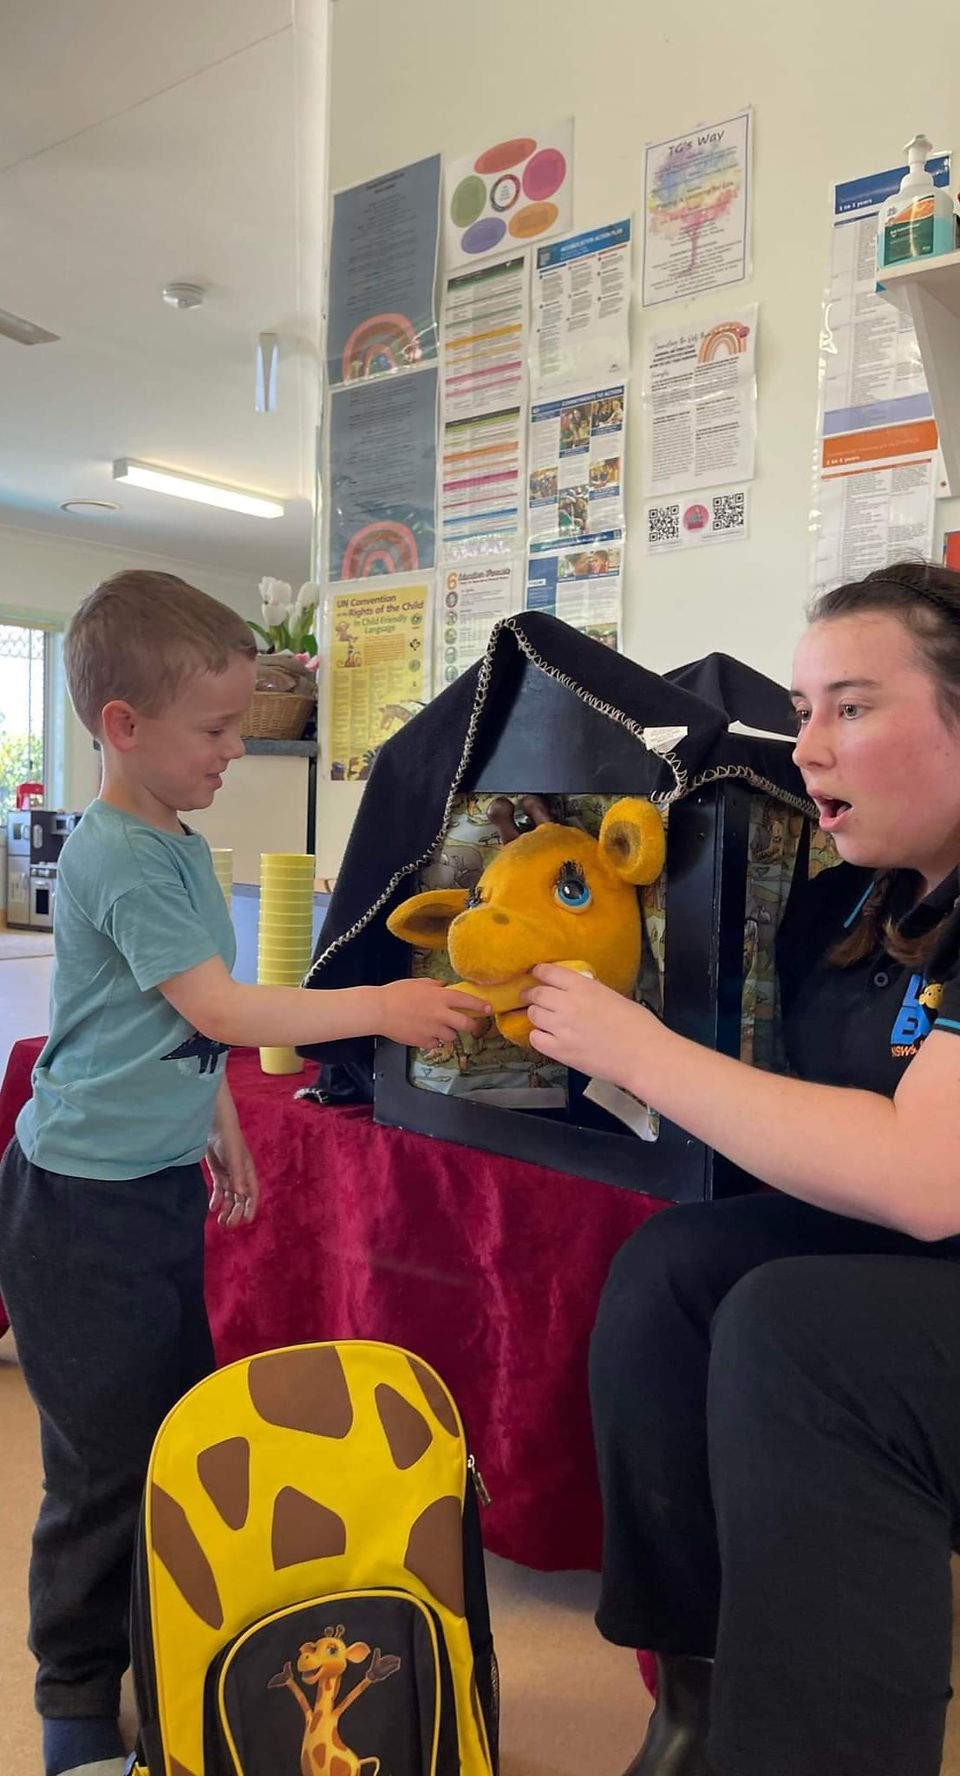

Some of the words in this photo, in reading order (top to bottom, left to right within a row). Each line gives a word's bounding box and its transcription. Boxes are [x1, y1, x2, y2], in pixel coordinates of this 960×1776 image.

[698, 130, 725, 146] Way
[857, 198, 873, 208] years
[447, 572, 457, 590] 6
[337, 599, 349, 608] UN
[350, 595, 397, 607] Convention
[348, 608, 373, 618] Rights
[375, 604, 384, 613] of
[386, 603, 400, 613] the
[402, 600, 424, 611] Child
[361, 616, 379, 626] Child
[380, 614, 408, 624] Friendly
[364, 624, 396, 635] Language
